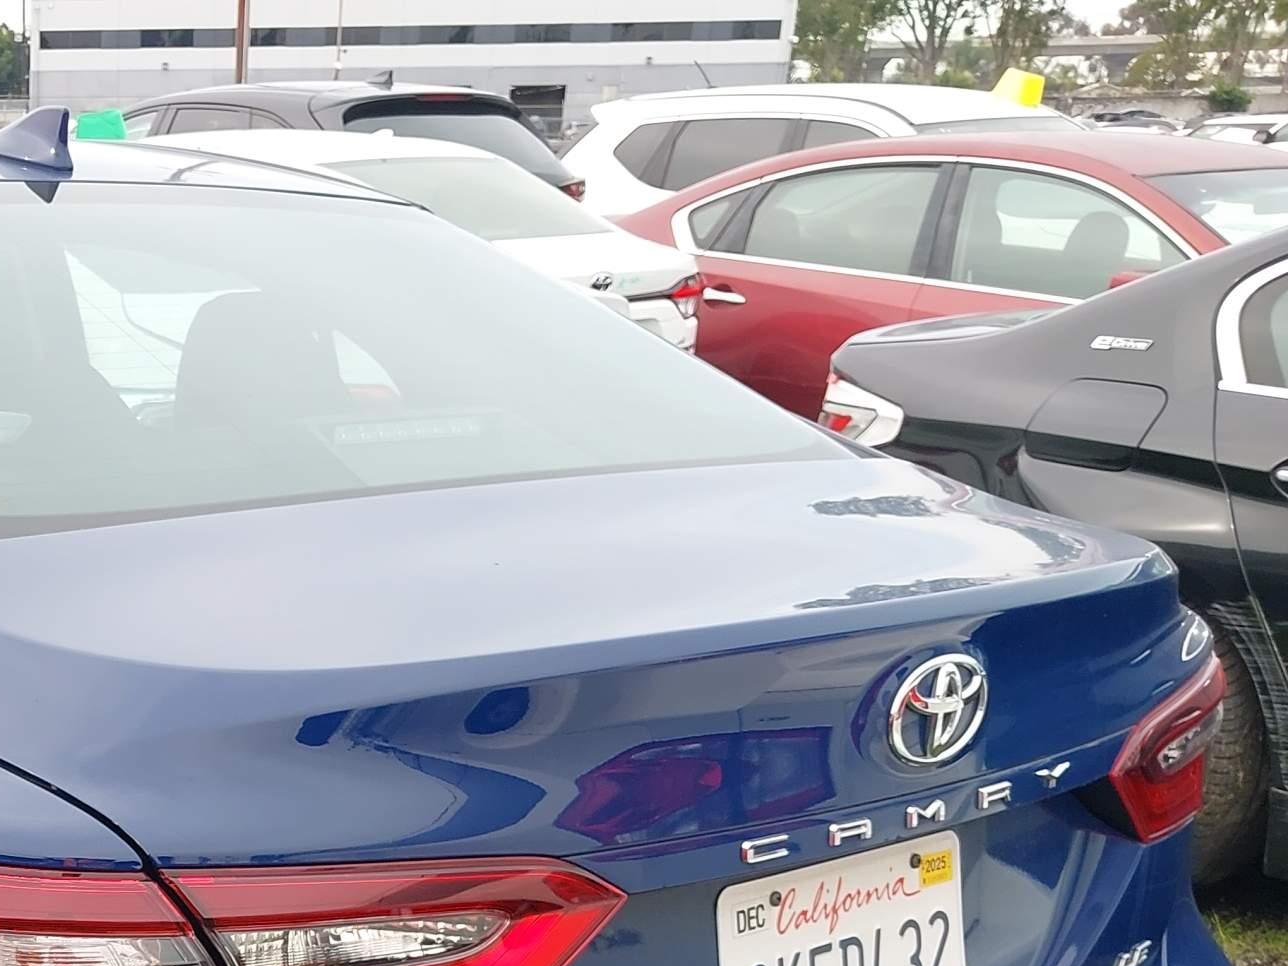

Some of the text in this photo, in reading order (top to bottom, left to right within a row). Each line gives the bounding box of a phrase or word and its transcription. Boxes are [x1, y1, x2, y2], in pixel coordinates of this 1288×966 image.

[742, 761, 1070, 864] CAMRY
[925, 855, 947, 873] 2025
[736, 904, 766, 934] DEC
[775, 866, 920, 935] California
